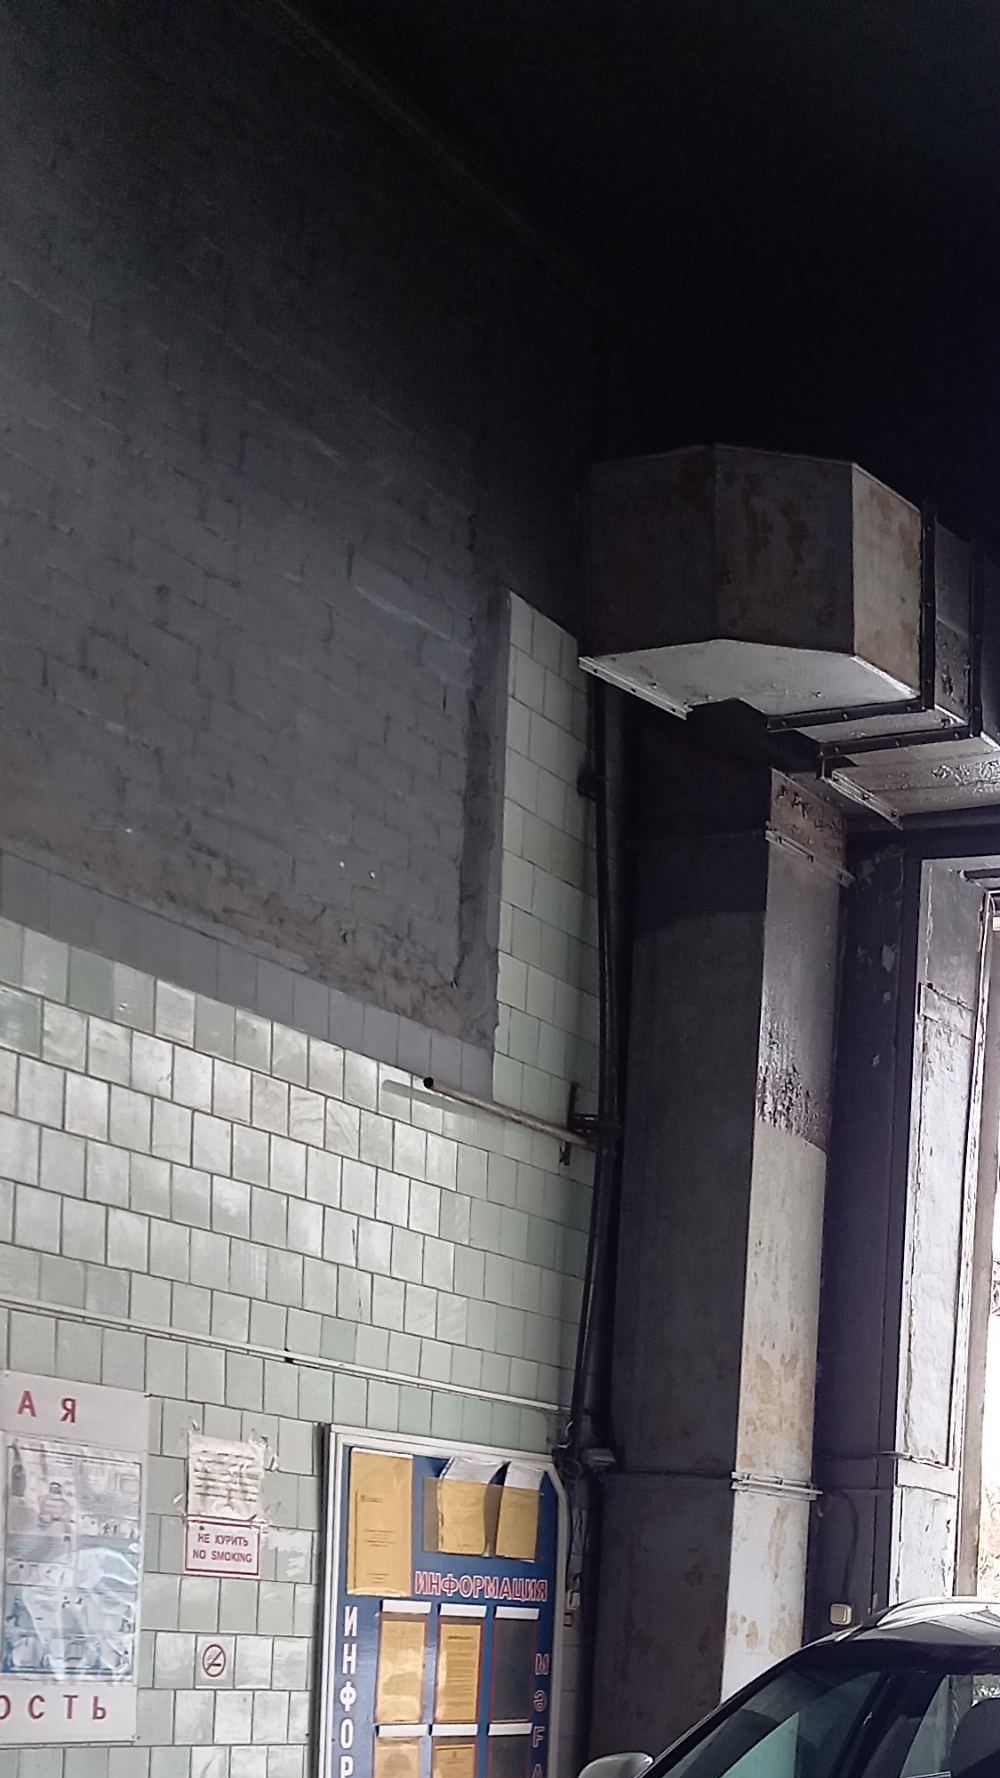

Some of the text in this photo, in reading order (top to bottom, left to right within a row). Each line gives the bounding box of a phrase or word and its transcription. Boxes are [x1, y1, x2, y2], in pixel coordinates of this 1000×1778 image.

[198, 1533, 249, 1547] НЕ КУРИТЬ
[193, 1549, 252, 1563] NO SMOKING
[415, 1570, 548, 1602] ИНФОРМАЦИЯ
